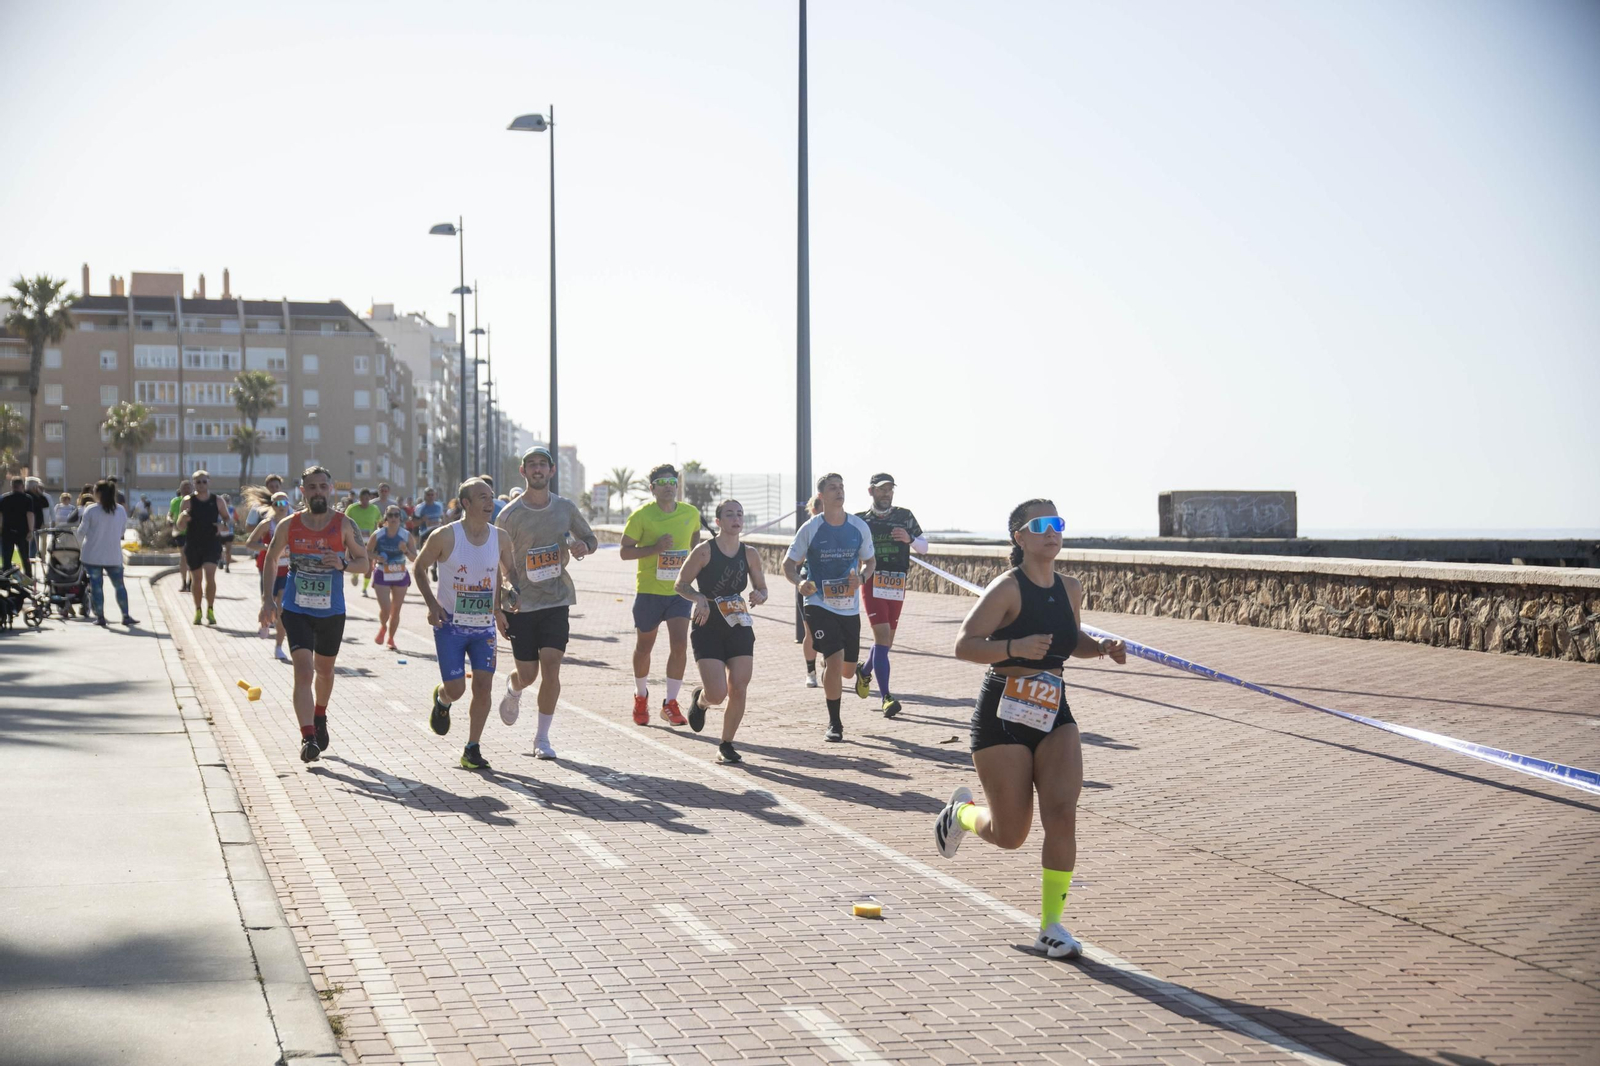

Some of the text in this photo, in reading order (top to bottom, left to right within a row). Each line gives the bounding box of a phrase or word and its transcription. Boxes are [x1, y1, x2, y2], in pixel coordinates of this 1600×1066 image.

[531, 551, 558, 565] 1138
[711, 565, 735, 597] NIKE
[730, 559, 745, 590] PRO
[877, 576, 902, 586] 1009
[301, 580, 325, 592] 319
[831, 585, 850, 595] 907
[461, 599, 491, 609] 1704
[1015, 677, 1057, 704] 1122
